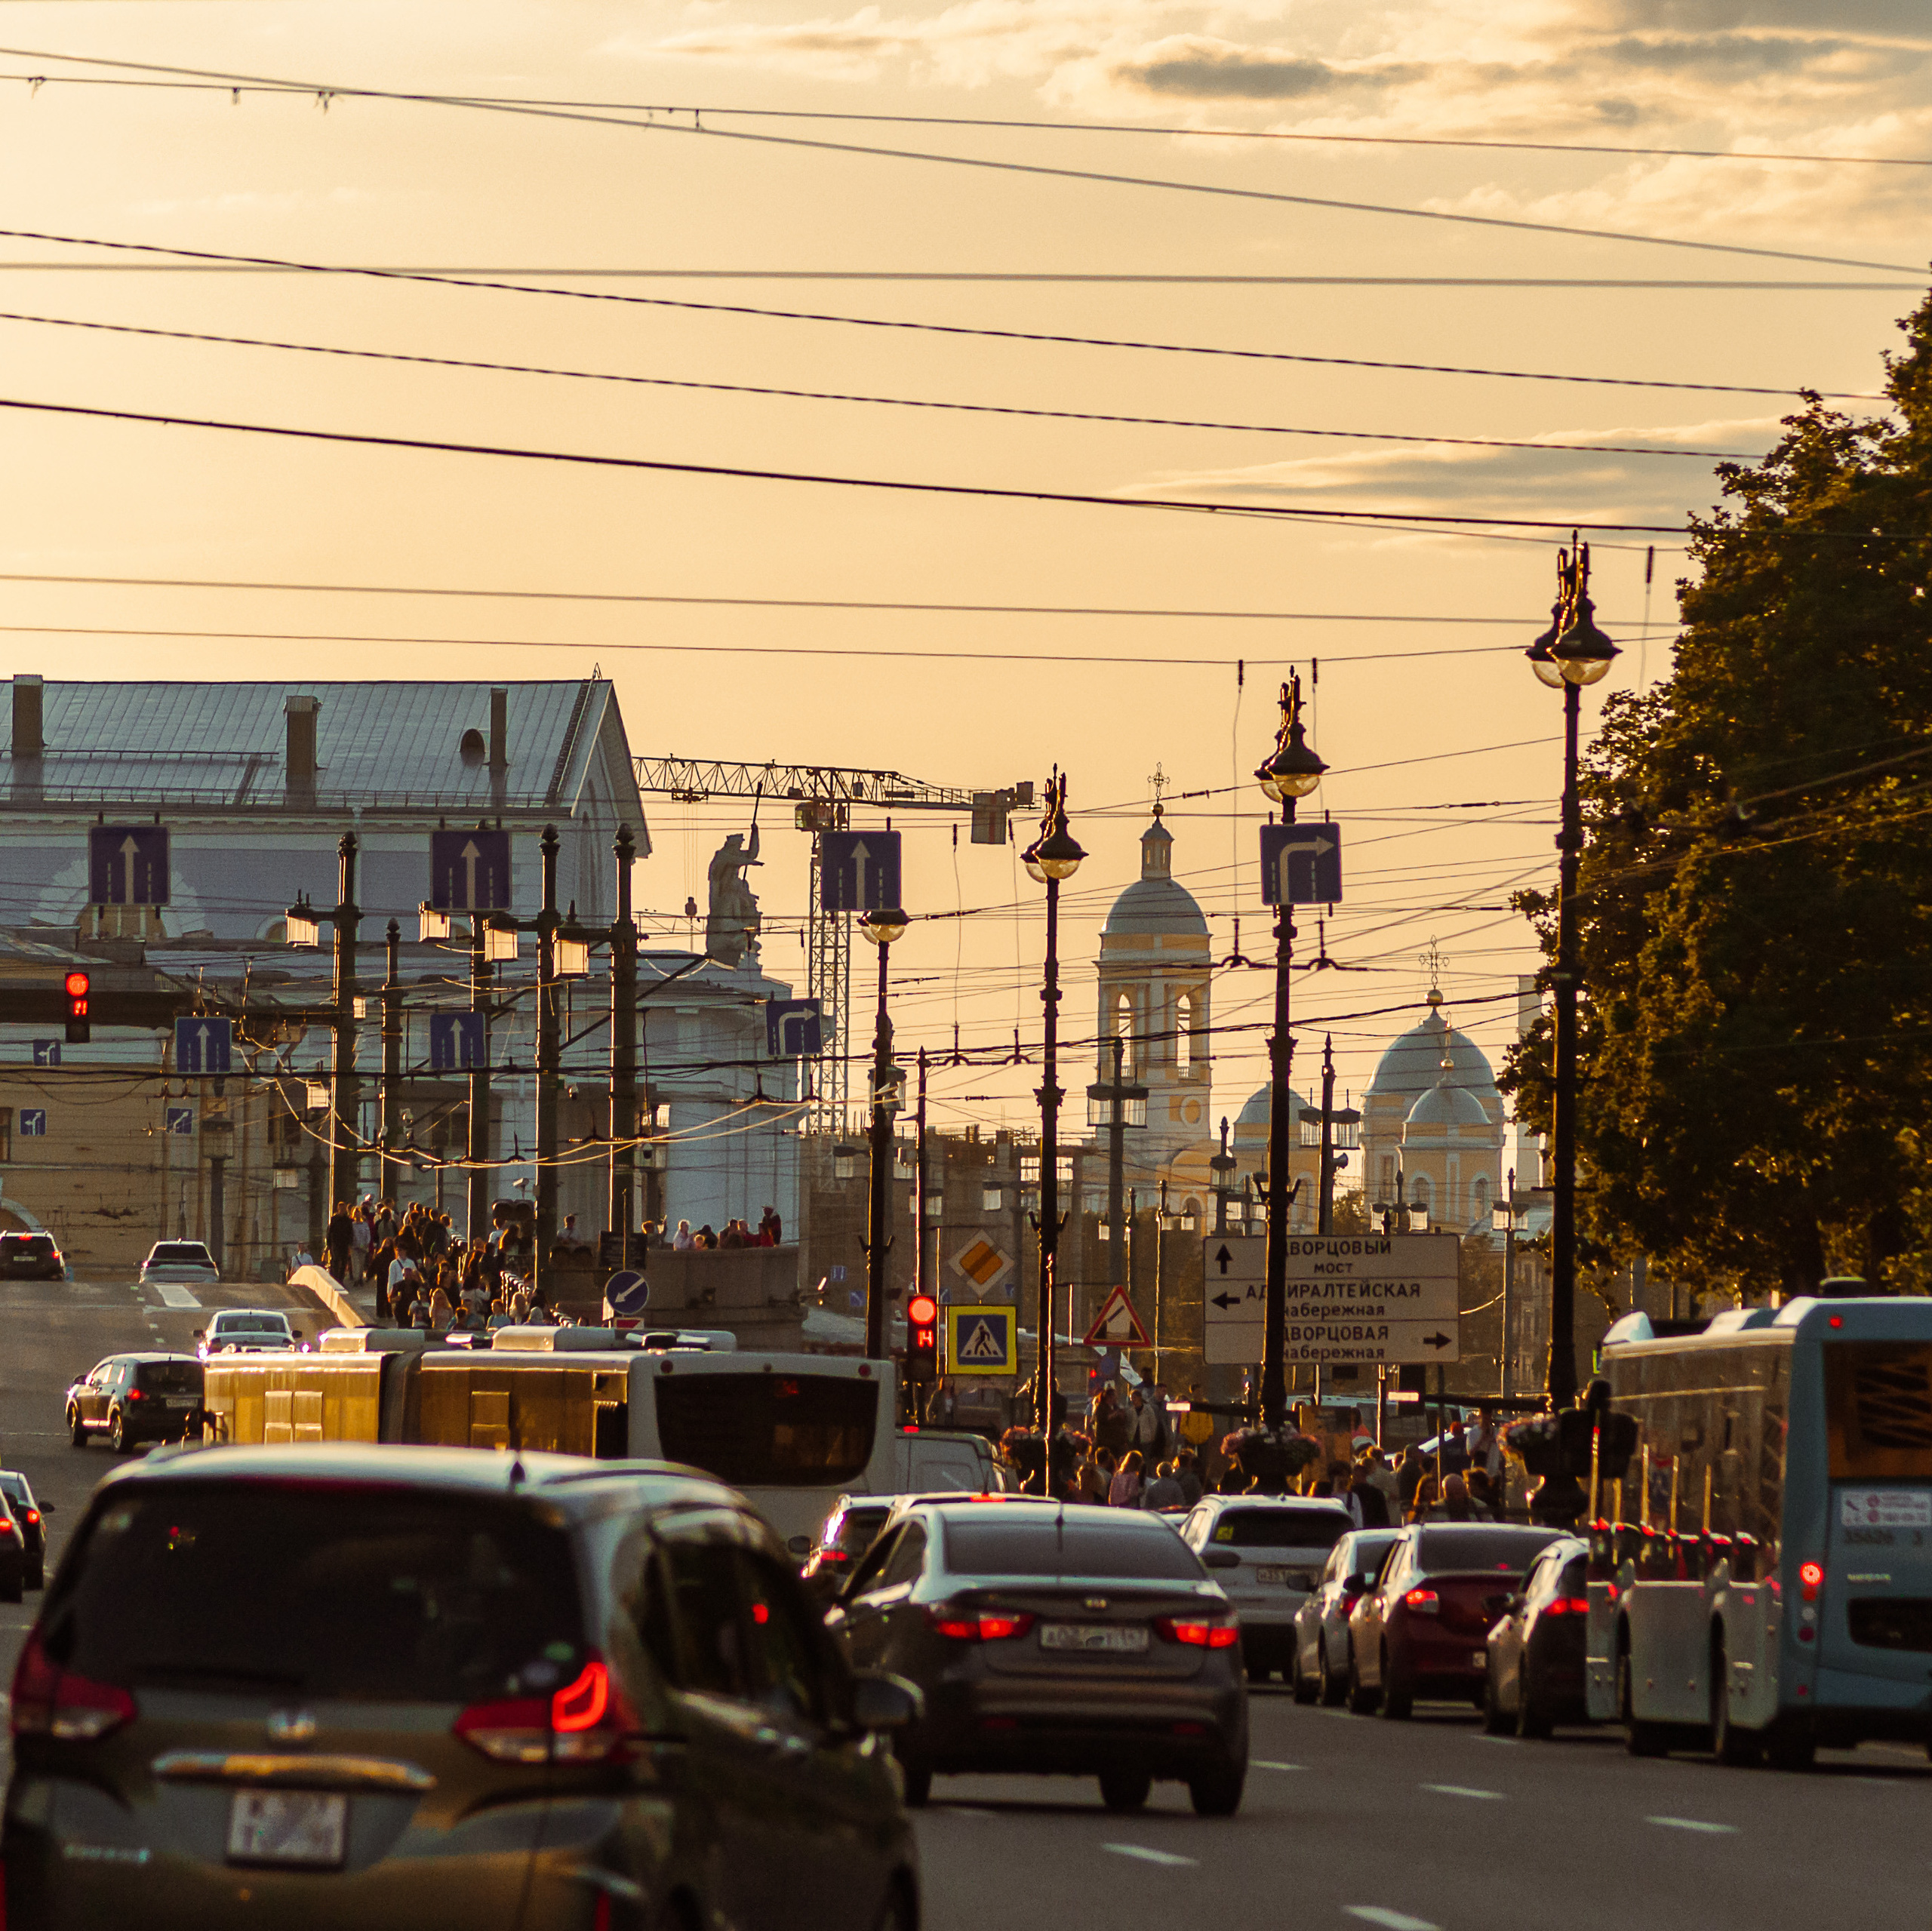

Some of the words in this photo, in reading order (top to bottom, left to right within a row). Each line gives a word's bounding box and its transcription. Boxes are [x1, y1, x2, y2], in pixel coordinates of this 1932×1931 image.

[1286, 1237, 1391, 1257] ВОРЦОВЫЙ
[1314, 1262, 1352, 1274] мост
[1246, 1280, 1420, 1299] АДИРАЛТЕЙСКАЯ
